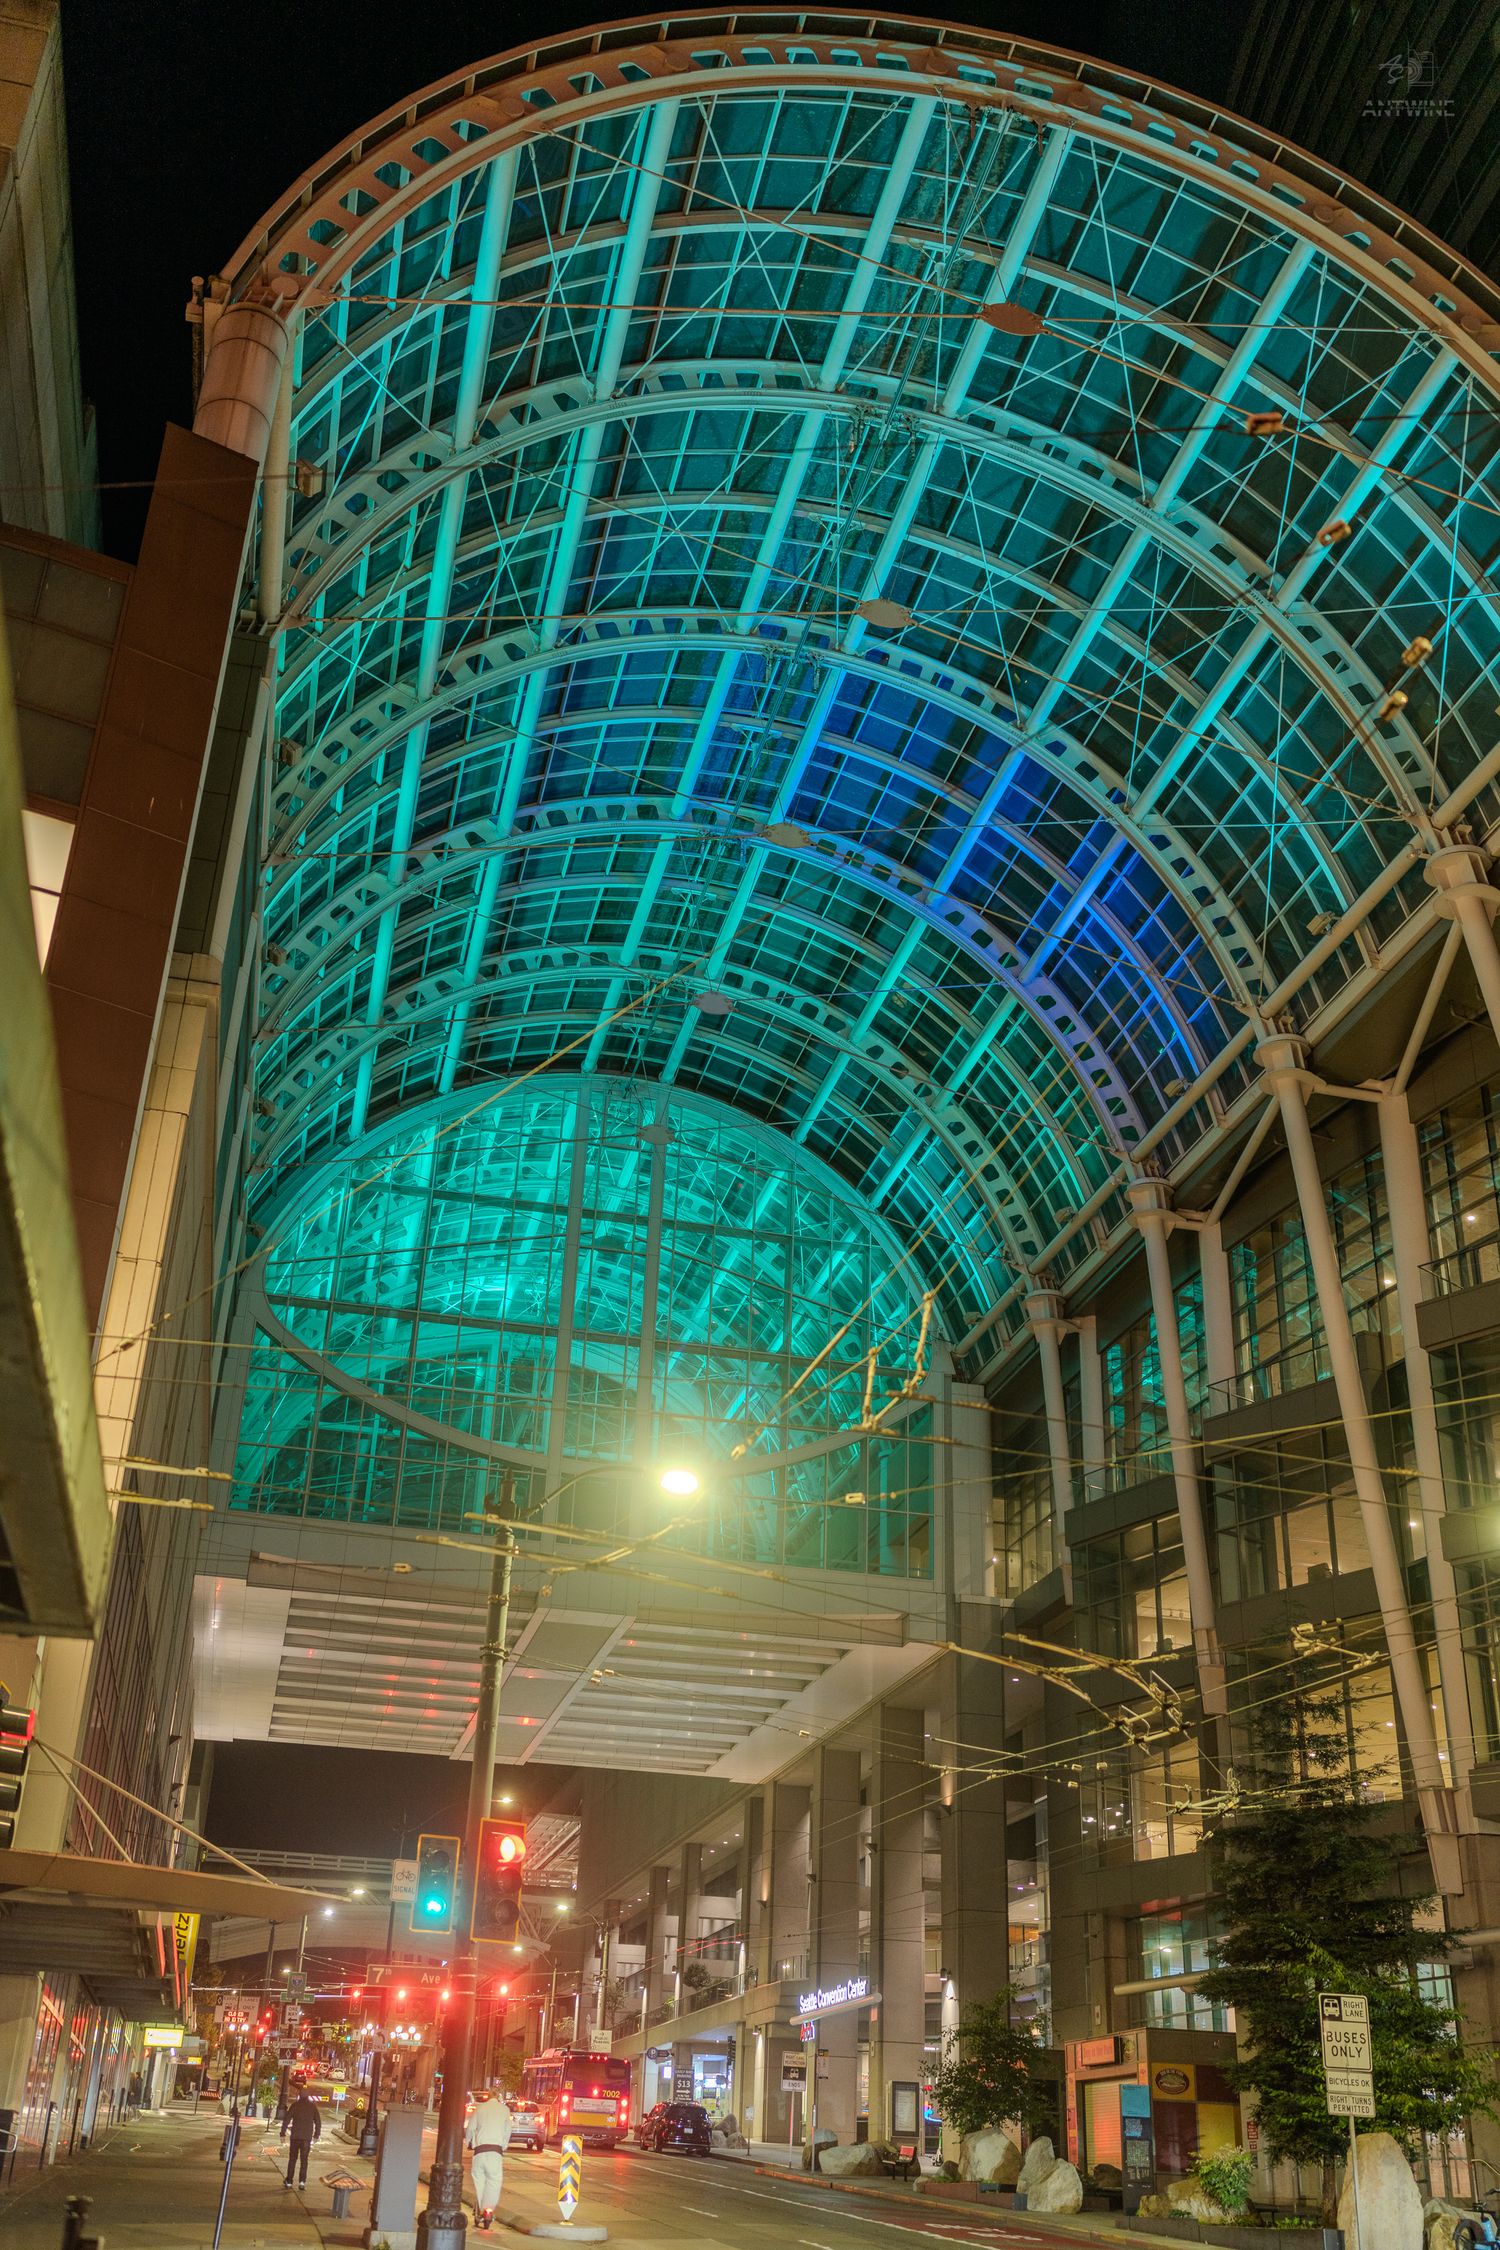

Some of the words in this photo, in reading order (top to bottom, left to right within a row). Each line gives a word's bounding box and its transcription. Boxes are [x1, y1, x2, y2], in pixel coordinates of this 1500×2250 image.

[393, 1885, 415, 1894] SIGNAL
[421, 1972, 441, 1984] Ave
[799, 1993, 818, 2014] Seattle
[817, 1984, 848, 2008] Convention
[847, 1978, 867, 2000] Center
[1343, 2000, 1364, 2009] RIGHT
[1345, 2009, 1364, 2017] LANE
[1326, 2031, 1367, 2044] BUSES
[1331, 2045, 1363, 2058] ONLY
[677, 2080, 691, 2088] $13
[1329, 2077, 1360, 2087] BICYCLES
[1361, 2080, 1370, 2088] OK
[602, 2090, 620, 2098] 7002
[1330, 2095, 1348, 2104] RIGHT
[1352, 2097, 1372, 2106] TURNS
[1333, 2104, 1370, 2114] PERMITTED
